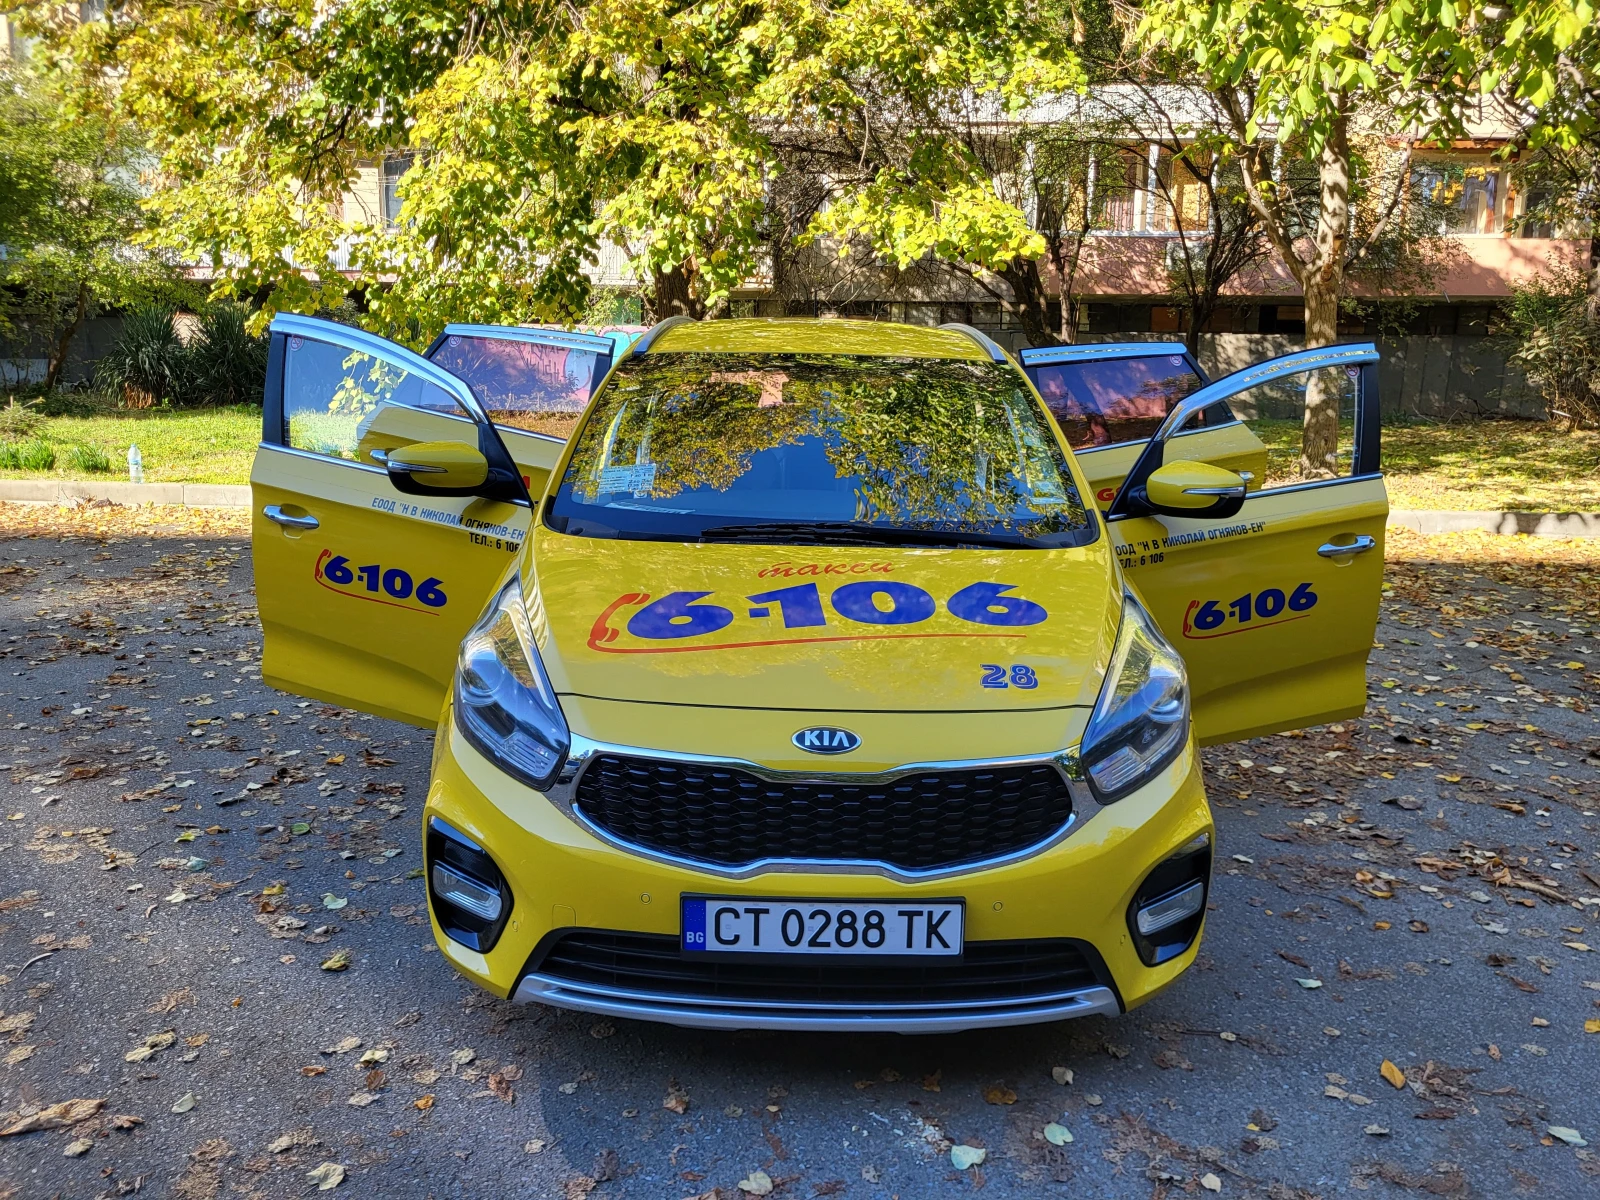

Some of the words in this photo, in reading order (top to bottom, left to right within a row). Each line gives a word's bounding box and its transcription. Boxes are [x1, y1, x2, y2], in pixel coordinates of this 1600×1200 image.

[371, 497, 396, 513] ЕООД
[411, 505, 418, 516] В
[420, 507, 464, 526] НИКОЛАЙ
[469, 532, 493, 547] ТЕЛ.:
[495, 538, 502, 549] 6
[1115, 544, 1136, 556] ООД
[1152, 538, 1160, 550] В
[1162, 530, 1206, 548] НИКОЛАЙ
[1208, 521, 1266, 540] ОГНЯНОВ-ЕН"
[1140, 554, 1146, 566] 6
[1149, 552, 1164, 564] 106
[757, 561, 896, 579] такси
[980, 663, 1039, 689] 28
[803, 729, 851, 749] KIA
[714, 906, 770, 947] CT
[781, 908, 886, 948] 0288
[897, 909, 952, 949] TK
[686, 931, 705, 945] BG
